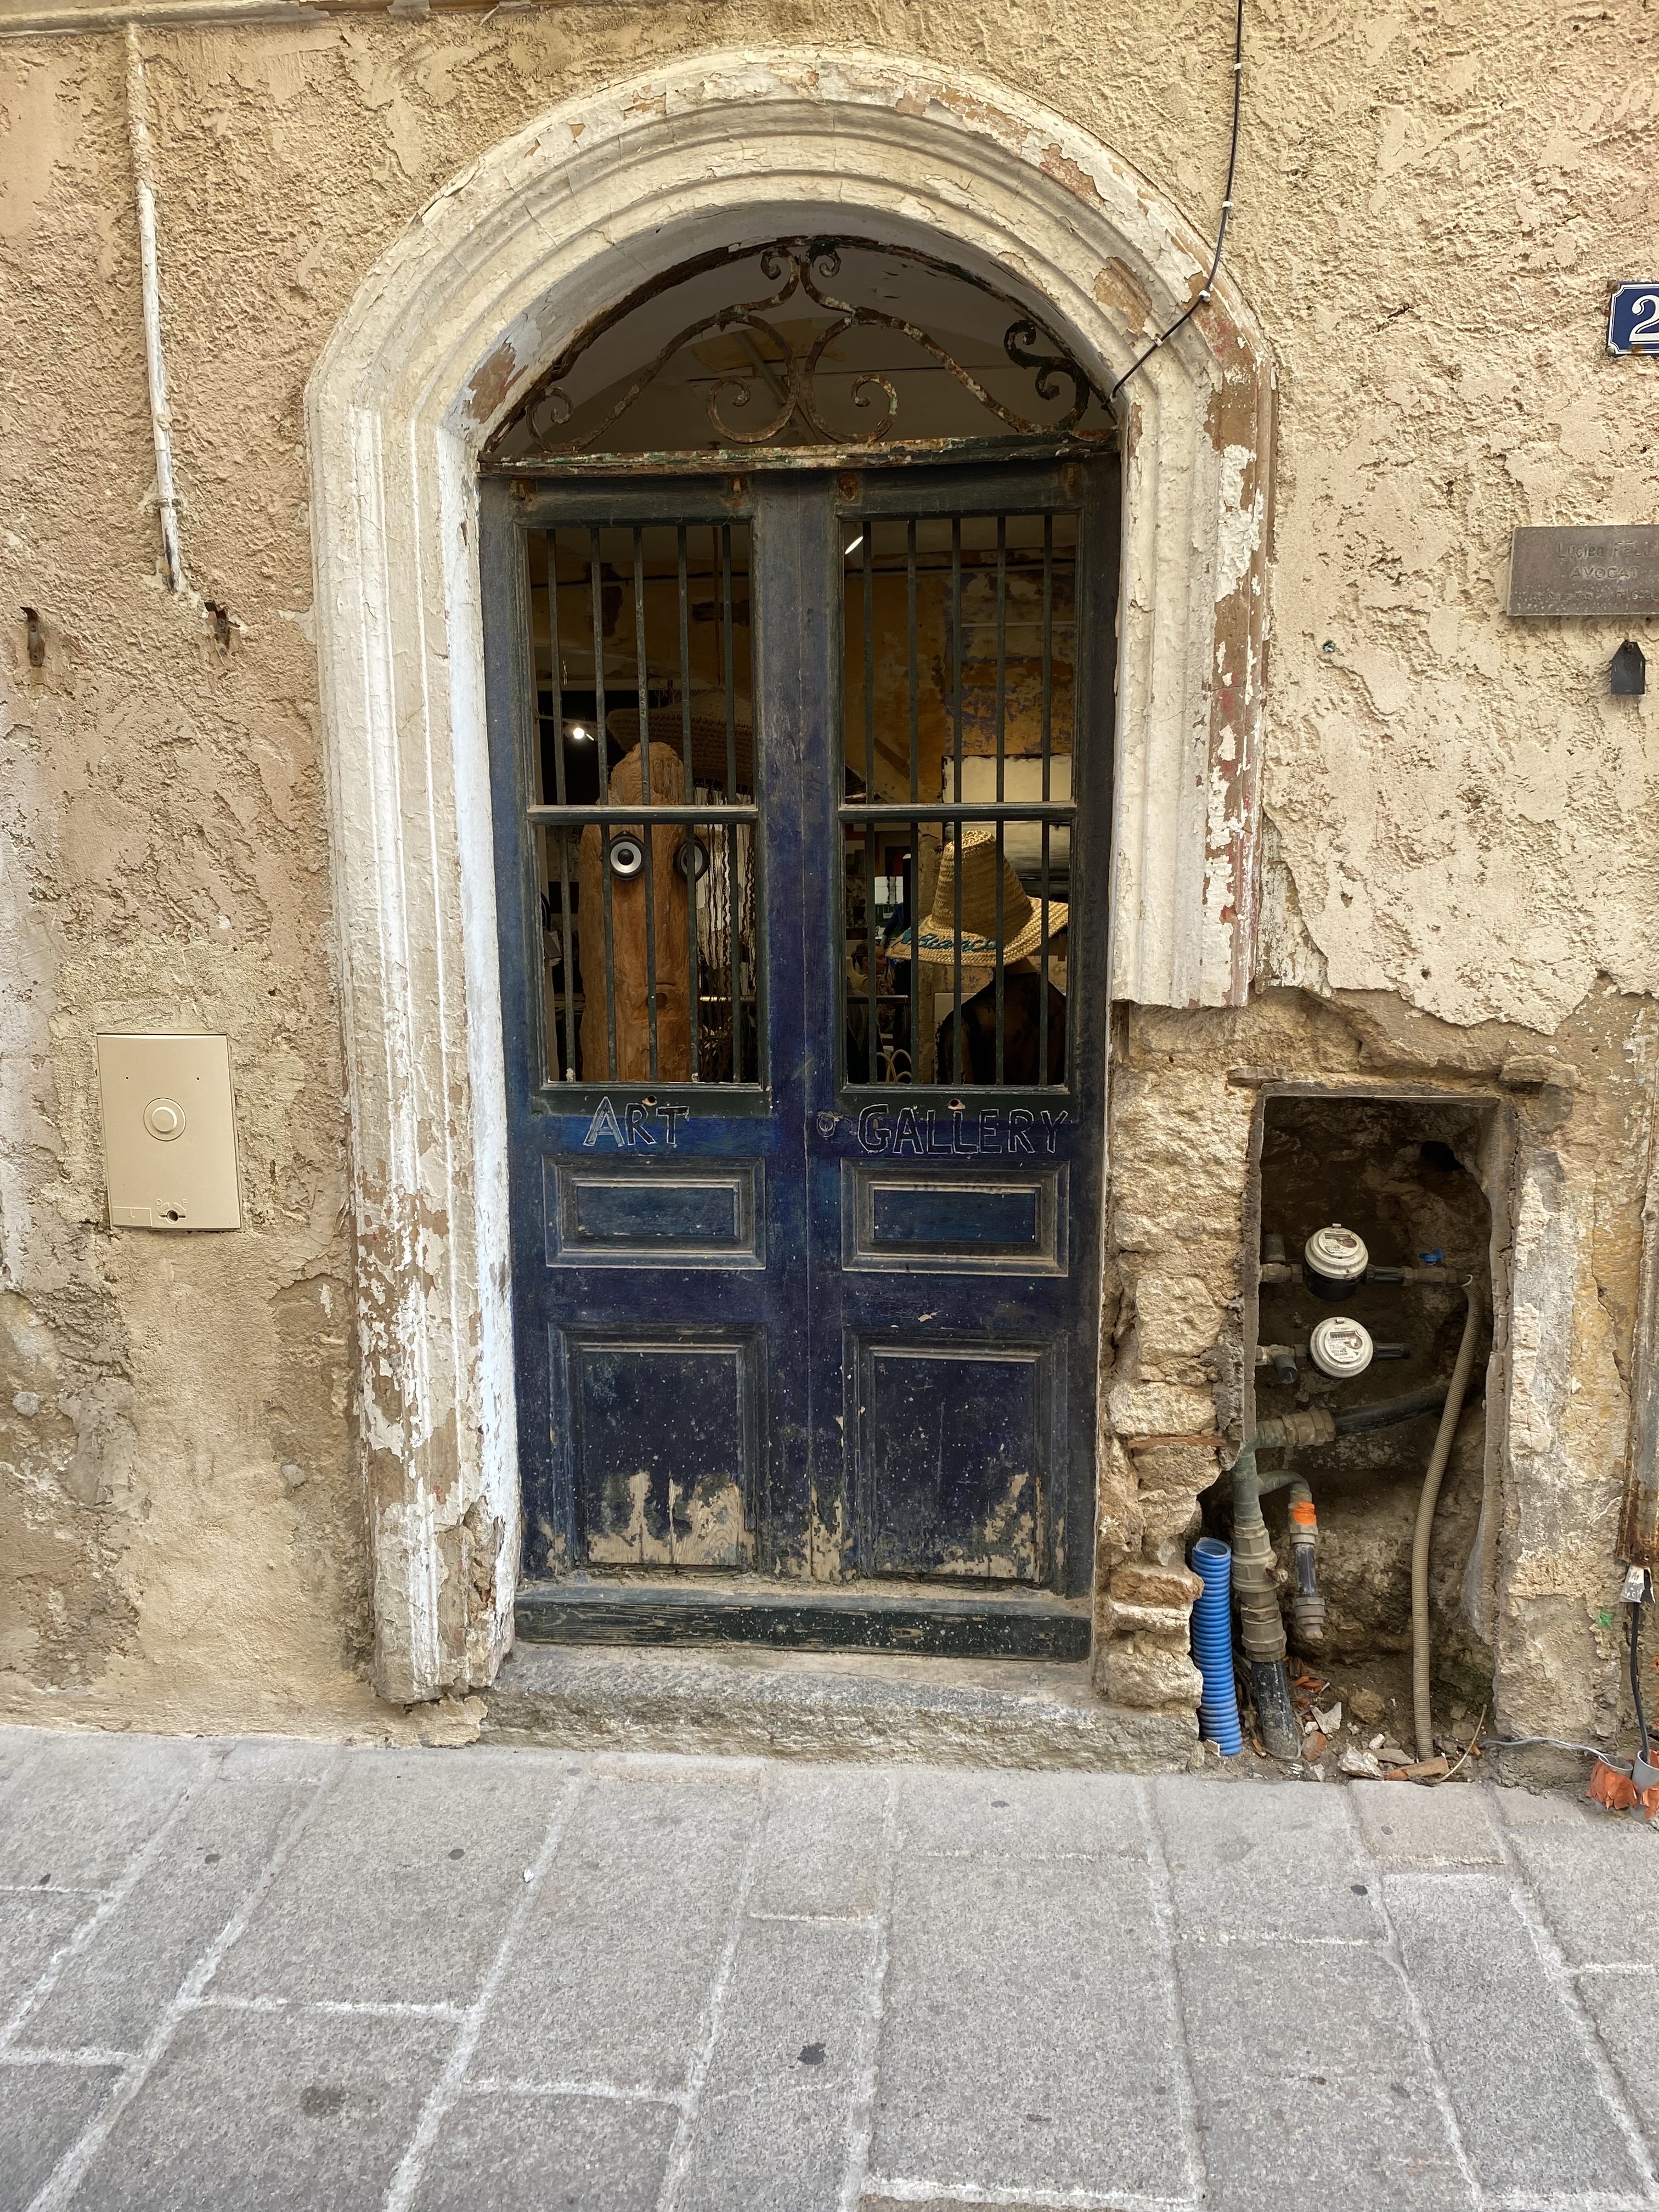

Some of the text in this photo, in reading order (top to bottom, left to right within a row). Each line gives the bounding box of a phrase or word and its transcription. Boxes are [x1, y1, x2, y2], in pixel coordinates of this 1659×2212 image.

[1557, 541, 1605, 558] Lucien
[1570, 566, 1640, 579] AVOCAT
[583, 1096, 1069, 1154] ART GALLERY
